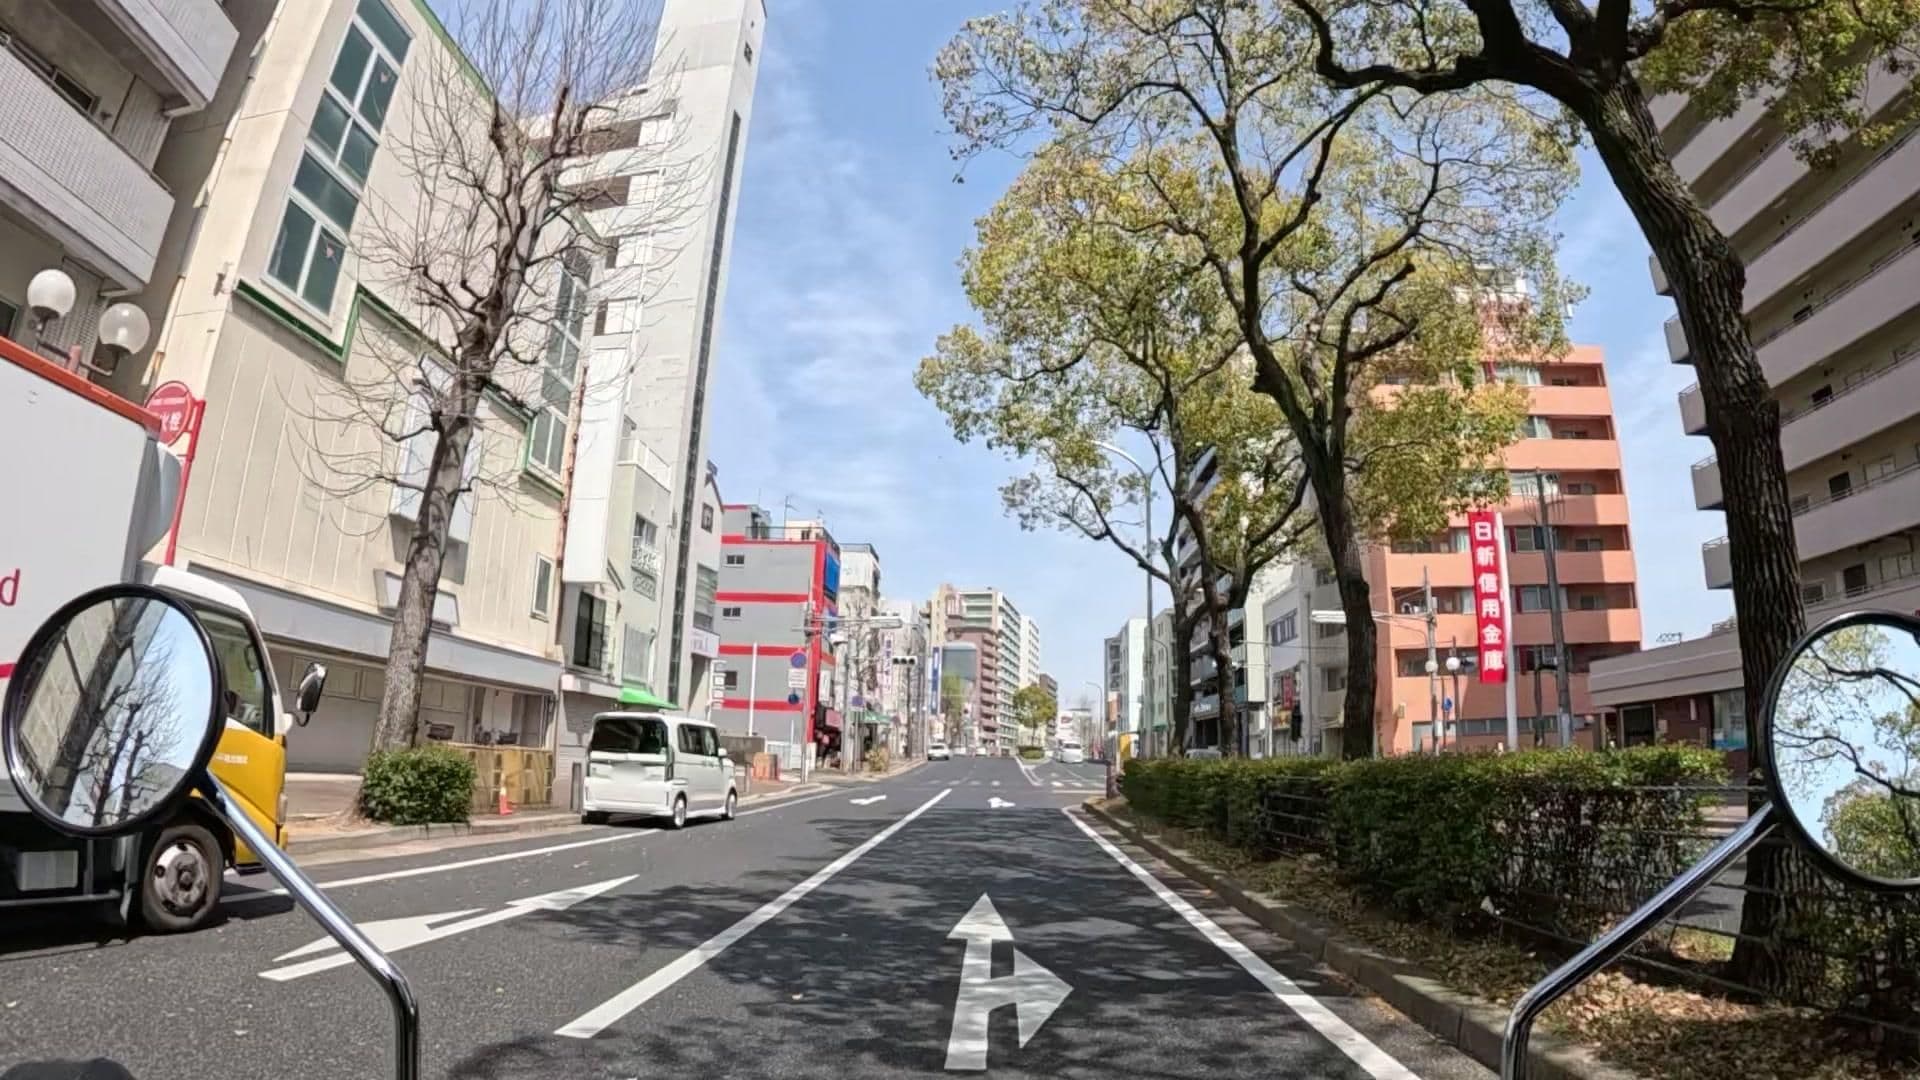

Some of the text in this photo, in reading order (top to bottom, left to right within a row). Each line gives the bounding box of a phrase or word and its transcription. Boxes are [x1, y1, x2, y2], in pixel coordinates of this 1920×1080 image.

[160, 411, 183, 432] 火栓
[1474, 521, 1505, 671] 日新信用金庫
